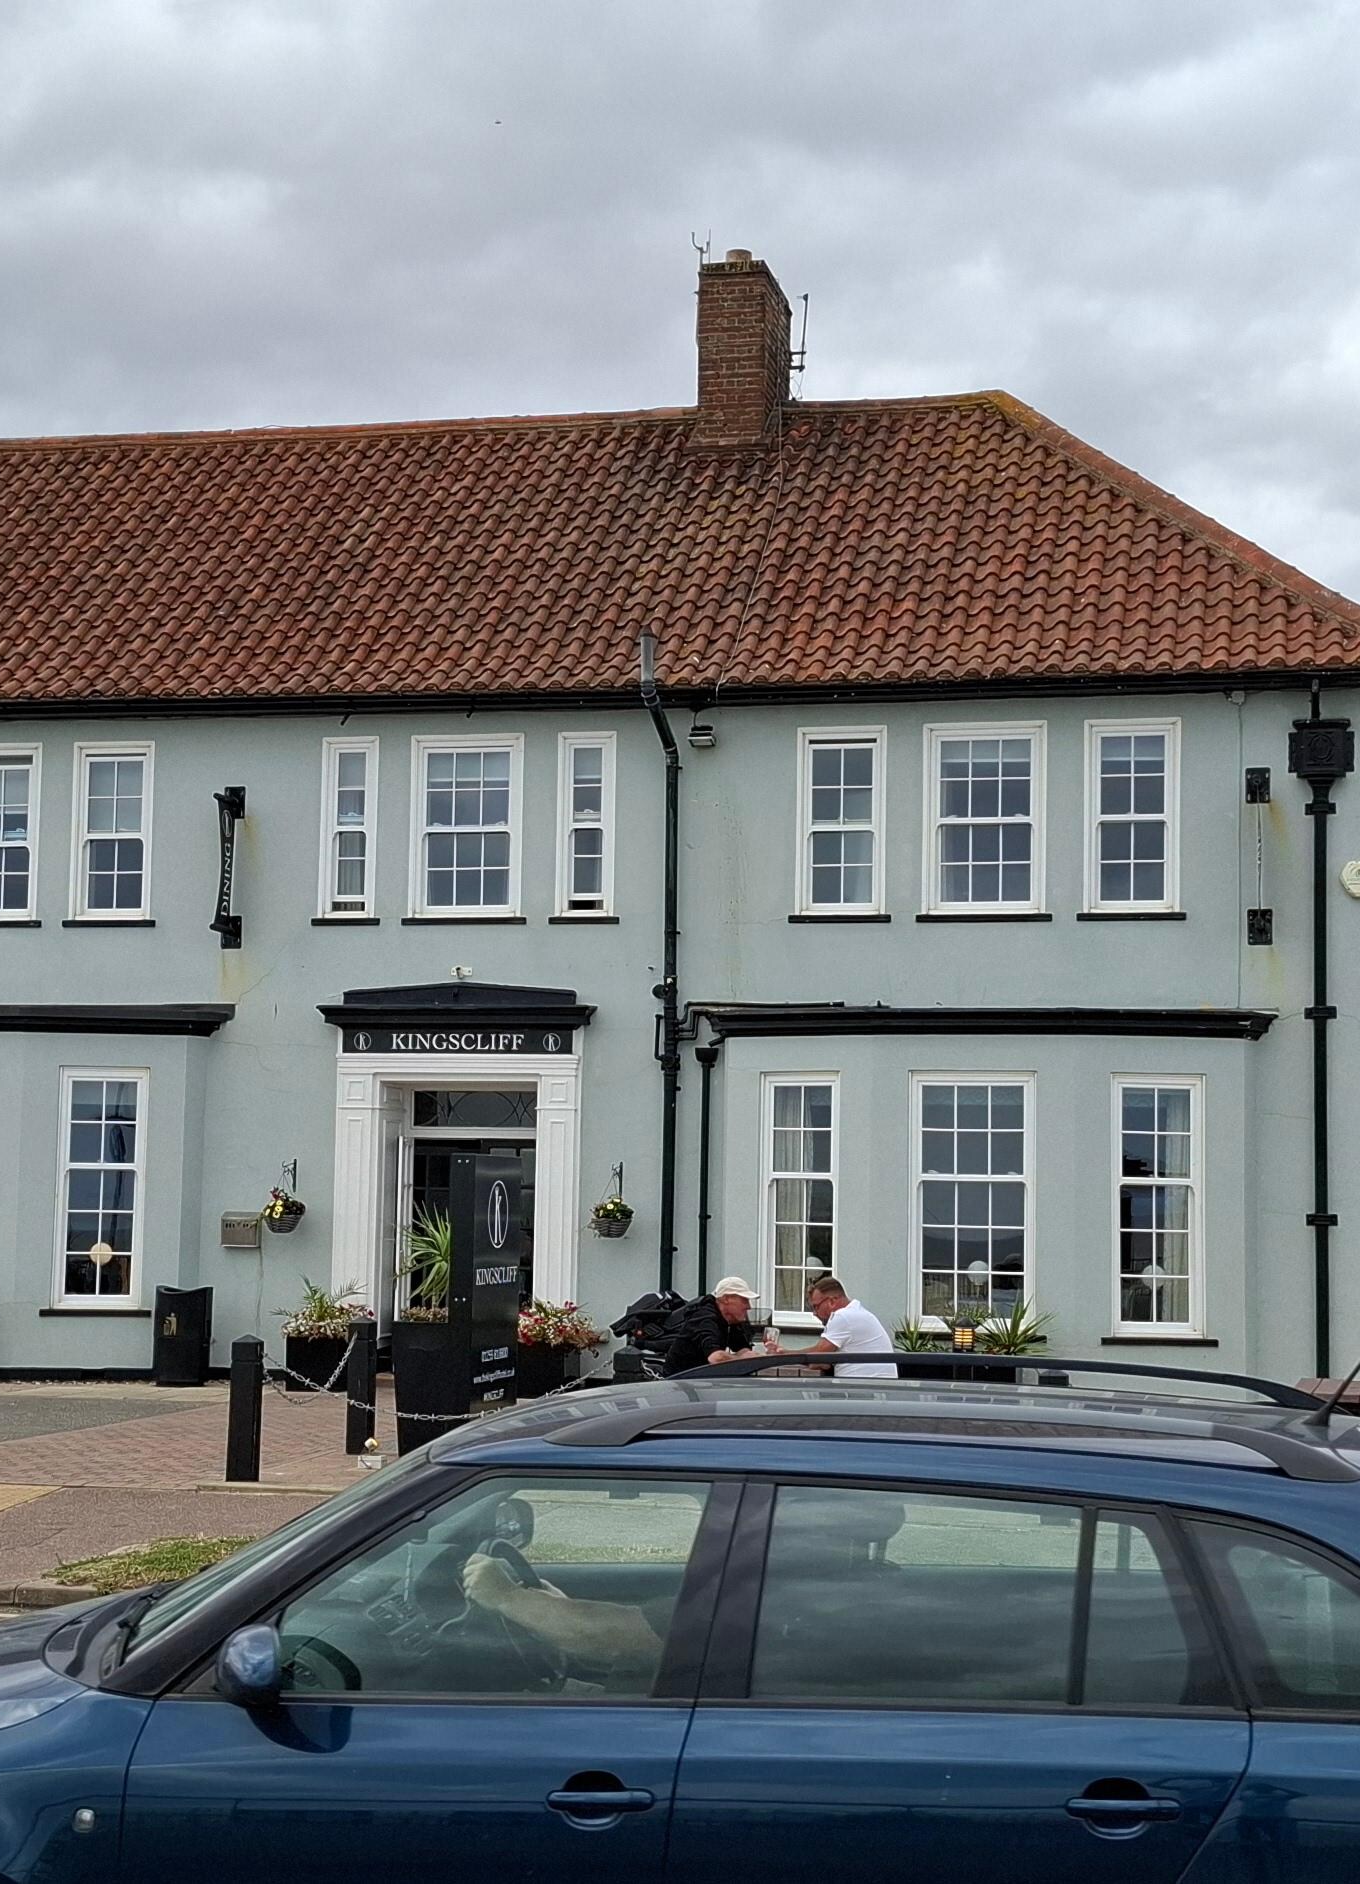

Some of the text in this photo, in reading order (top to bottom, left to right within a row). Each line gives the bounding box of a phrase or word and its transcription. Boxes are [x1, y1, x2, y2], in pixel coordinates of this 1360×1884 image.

[221, 843, 231, 916] DINING
[392, 1033, 524, 1050] KINGSCLIFF
[475, 1265, 518, 1286] KINGSCLIFF
